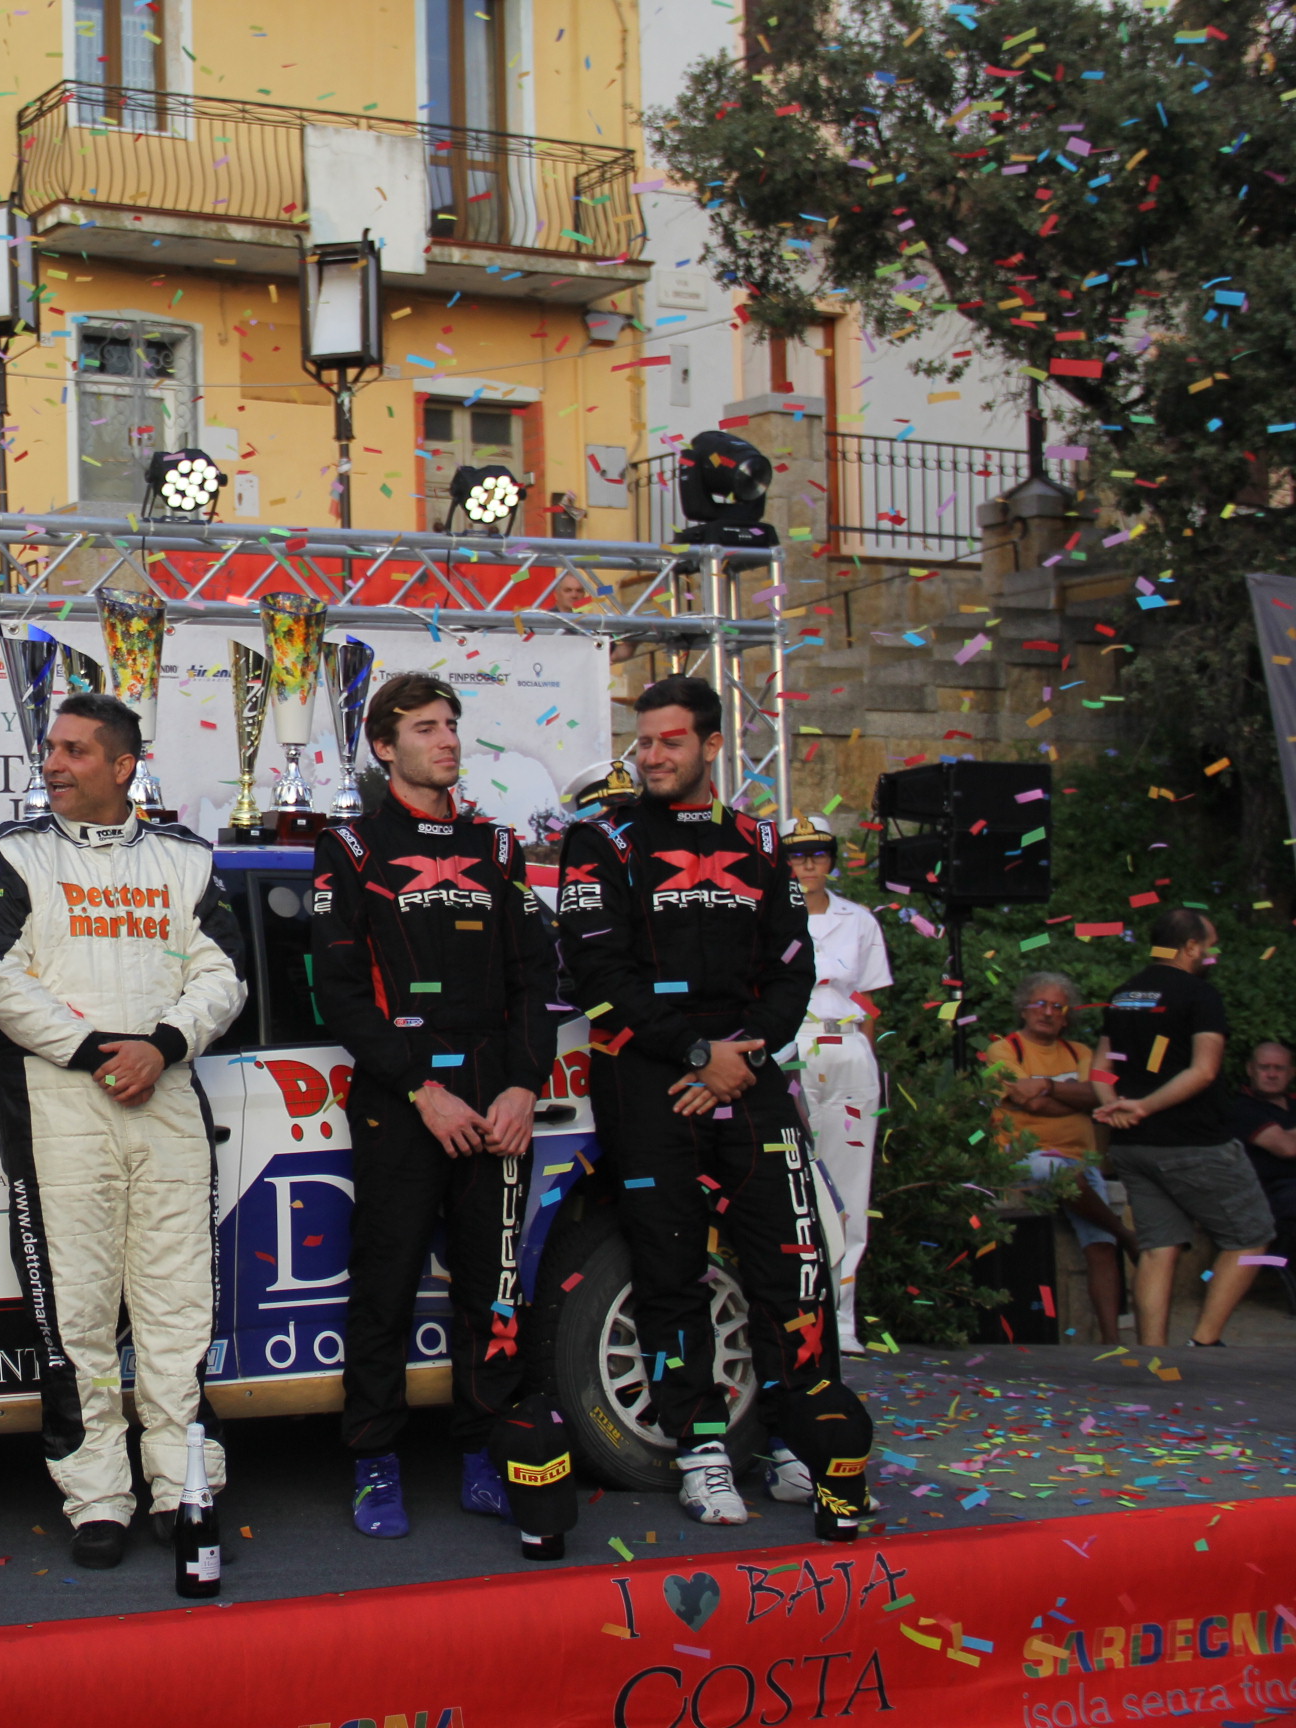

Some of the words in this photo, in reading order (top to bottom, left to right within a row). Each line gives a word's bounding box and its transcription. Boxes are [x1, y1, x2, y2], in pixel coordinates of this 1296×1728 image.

[418, 823, 454, 835] sparco
[677, 812, 712, 822] sparco
[339, 828, 364, 857] sparco
[57, 880, 171, 910] Dettori
[398, 890, 493, 907] RACE
[401, 901, 492, 912] SPORT
[652, 889, 757, 906] RACE
[653, 902, 757, 912] SPORT
[68, 907, 171, 941] market
[13, 1178, 65, 1370] www.dettorimarket.it
[513, 1458, 567, 1483] PIRELLI
[611, 1577, 640, 1640] I
[736, 1550, 907, 1643] BAJA
[1021, 1606, 1296, 1679] SARDEGNA
[612, 1648, 896, 1728] COSTA
[1021, 1681, 1116, 1728] isola
[1122, 1682, 1236, 1721] senza
